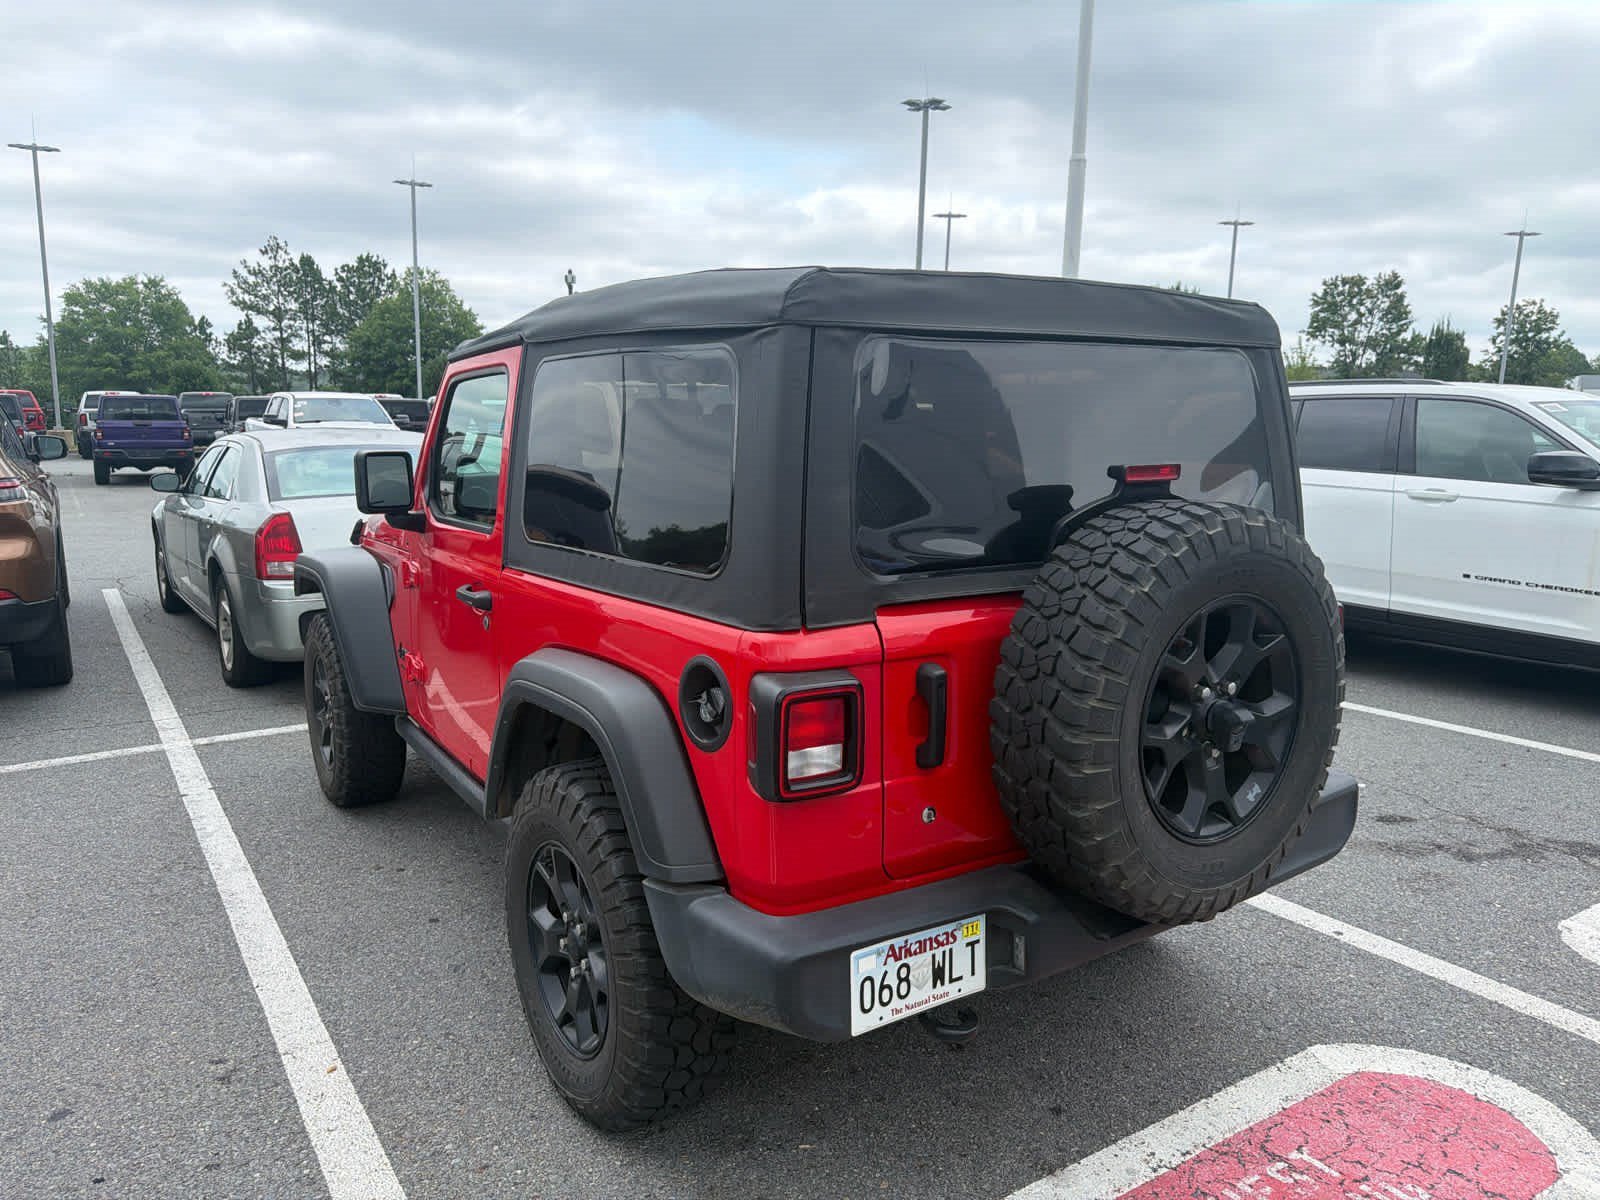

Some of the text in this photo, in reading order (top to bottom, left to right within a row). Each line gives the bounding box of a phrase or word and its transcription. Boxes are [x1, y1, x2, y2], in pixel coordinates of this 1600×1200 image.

[1474, 575, 1521, 586] GRAND
[883, 928, 958, 966] Arkansas
[860, 939, 980, 1014] 068 WLT
[890, 991, 950, 1017] The Natural State
